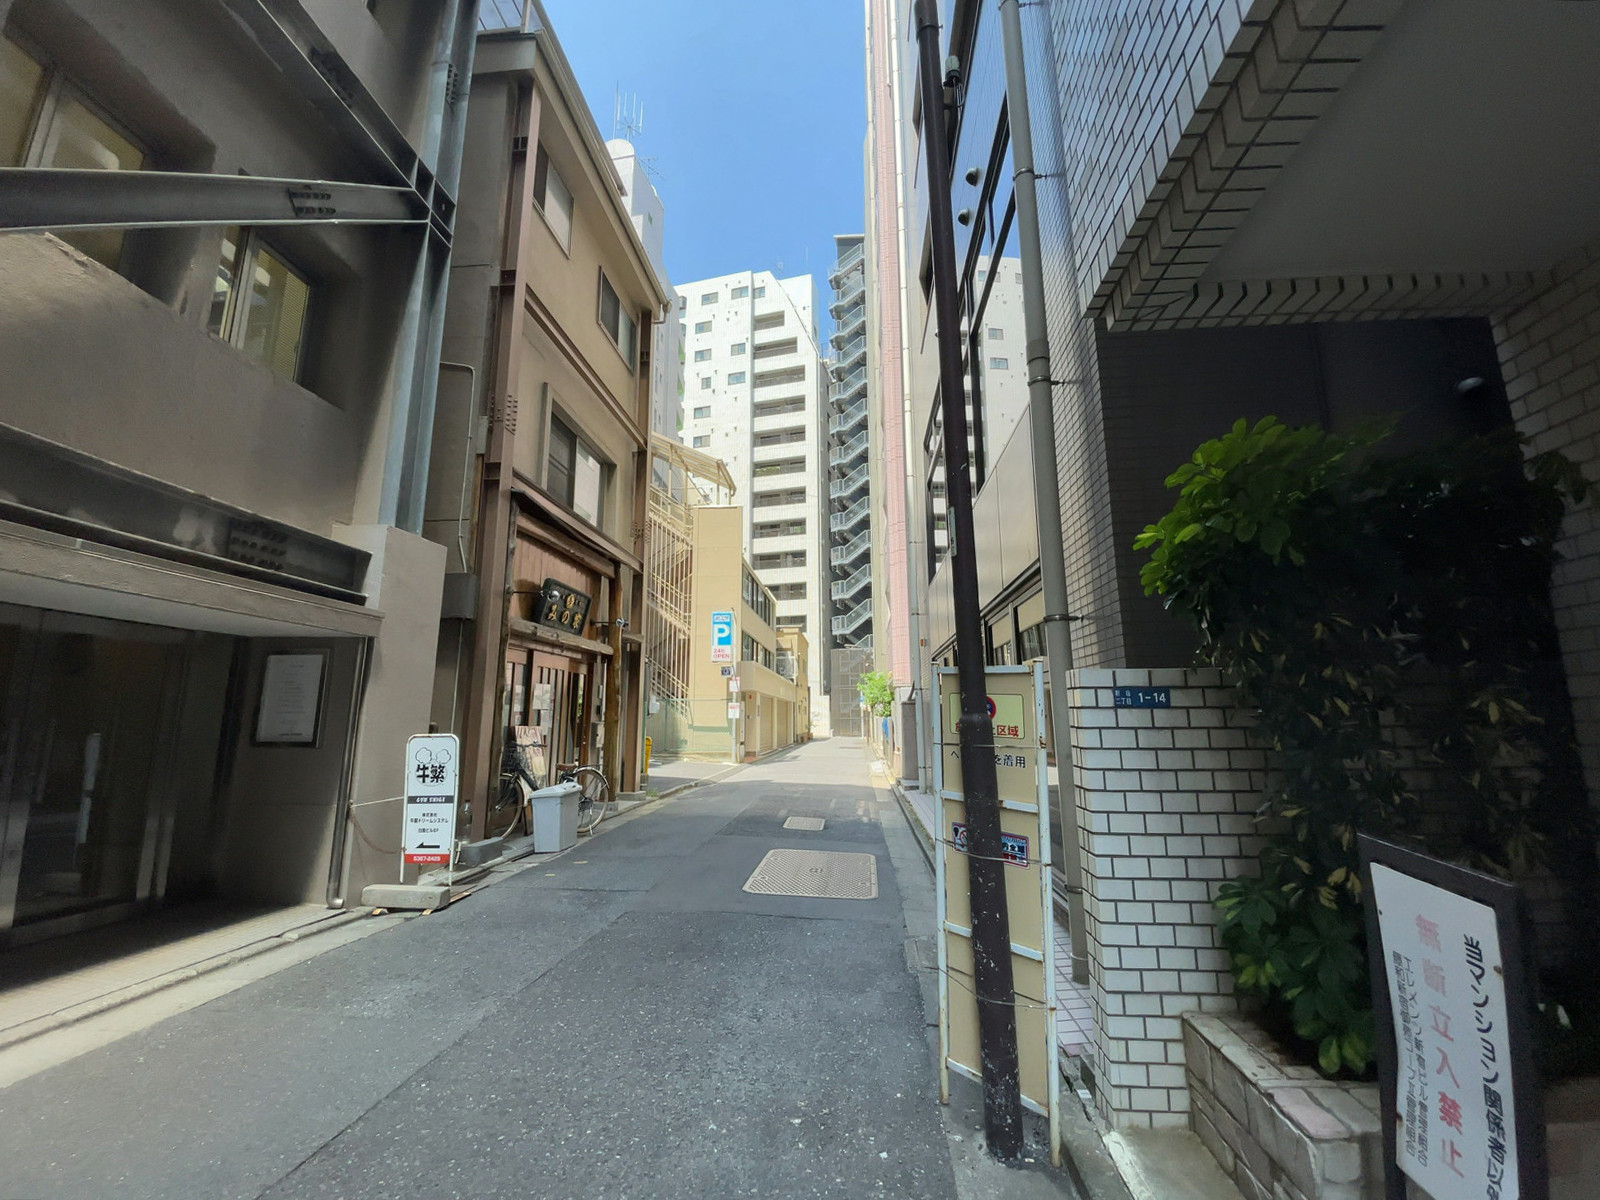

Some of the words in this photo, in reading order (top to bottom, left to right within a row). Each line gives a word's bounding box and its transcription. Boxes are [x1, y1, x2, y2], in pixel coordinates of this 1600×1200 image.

[714, 624, 730, 646] P
[1138, 692, 1166, 703] 1-14
[416, 764, 445, 783] 牛繁
[1415, 914, 1464, 1179] 無断立入禁止
